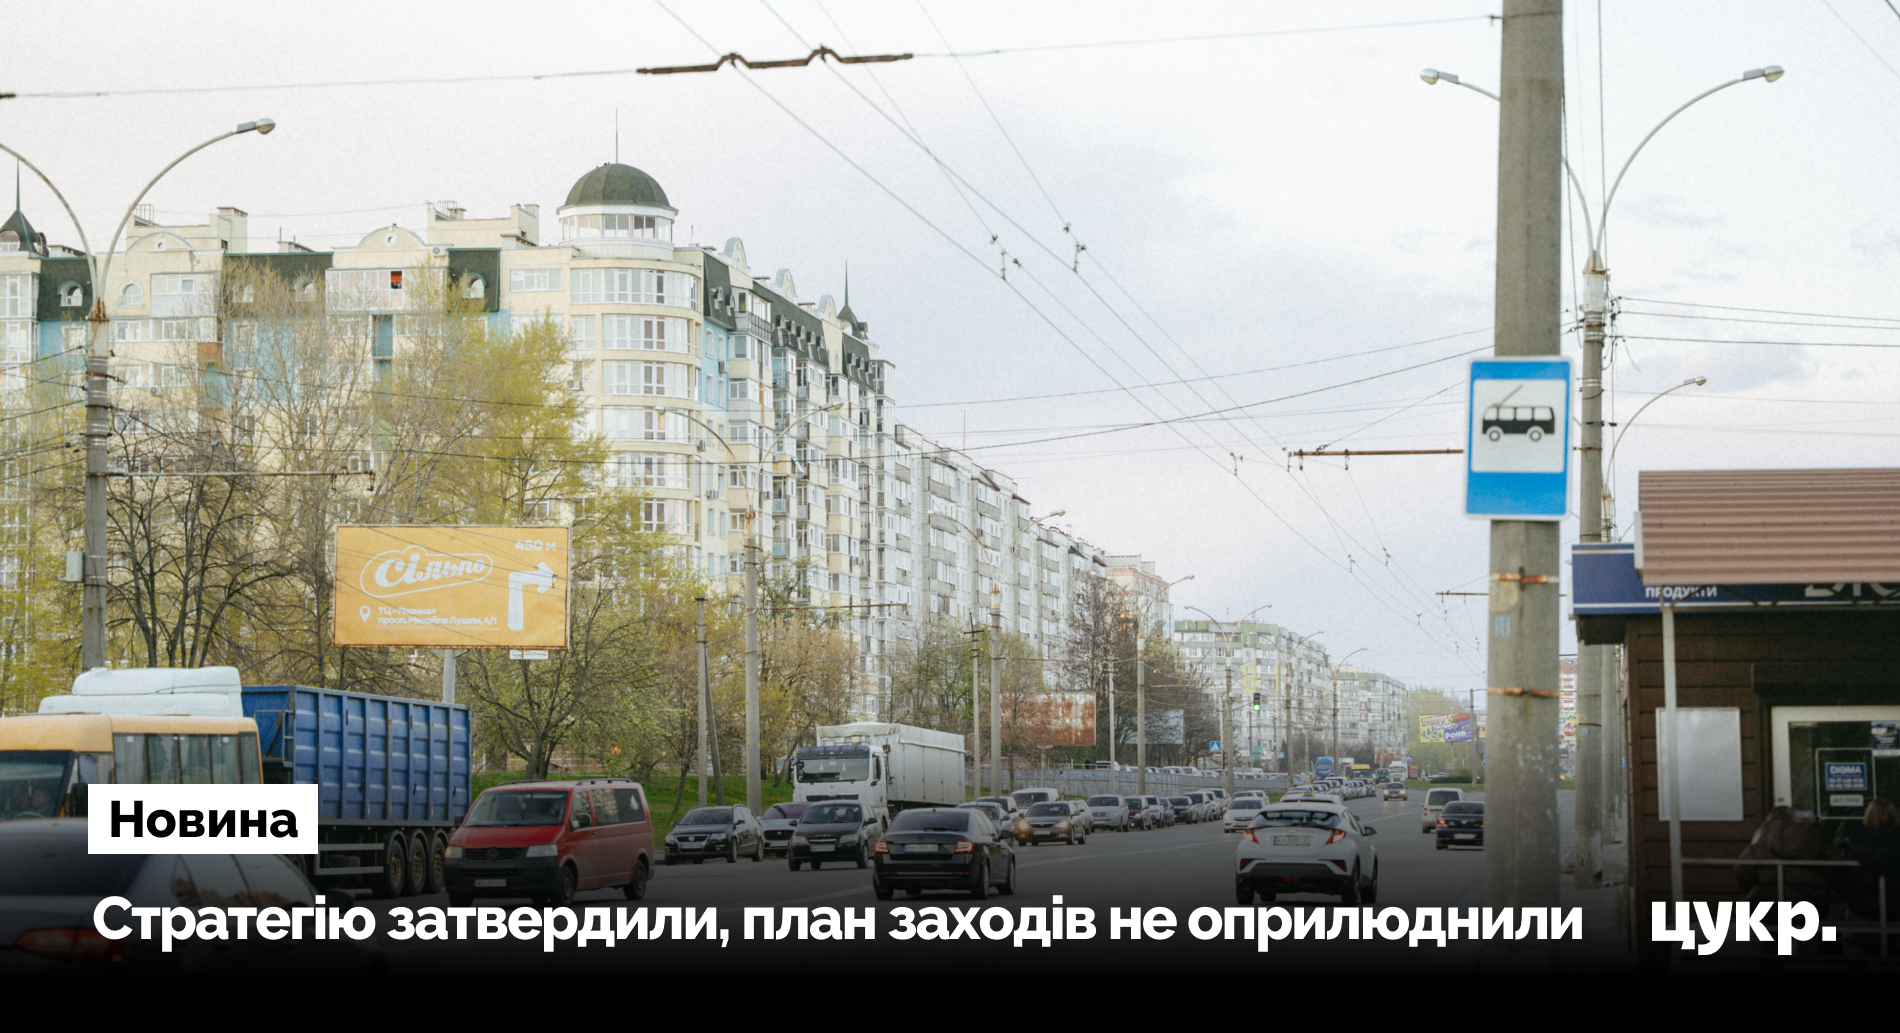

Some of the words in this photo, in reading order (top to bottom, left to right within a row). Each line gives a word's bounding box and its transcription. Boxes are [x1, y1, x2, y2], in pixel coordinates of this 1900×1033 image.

[515, 539, 543, 551] 450
[546, 542, 556, 551] м
[374, 552, 488, 588] Сільпо
[378, 606, 392, 616] ТЦ
